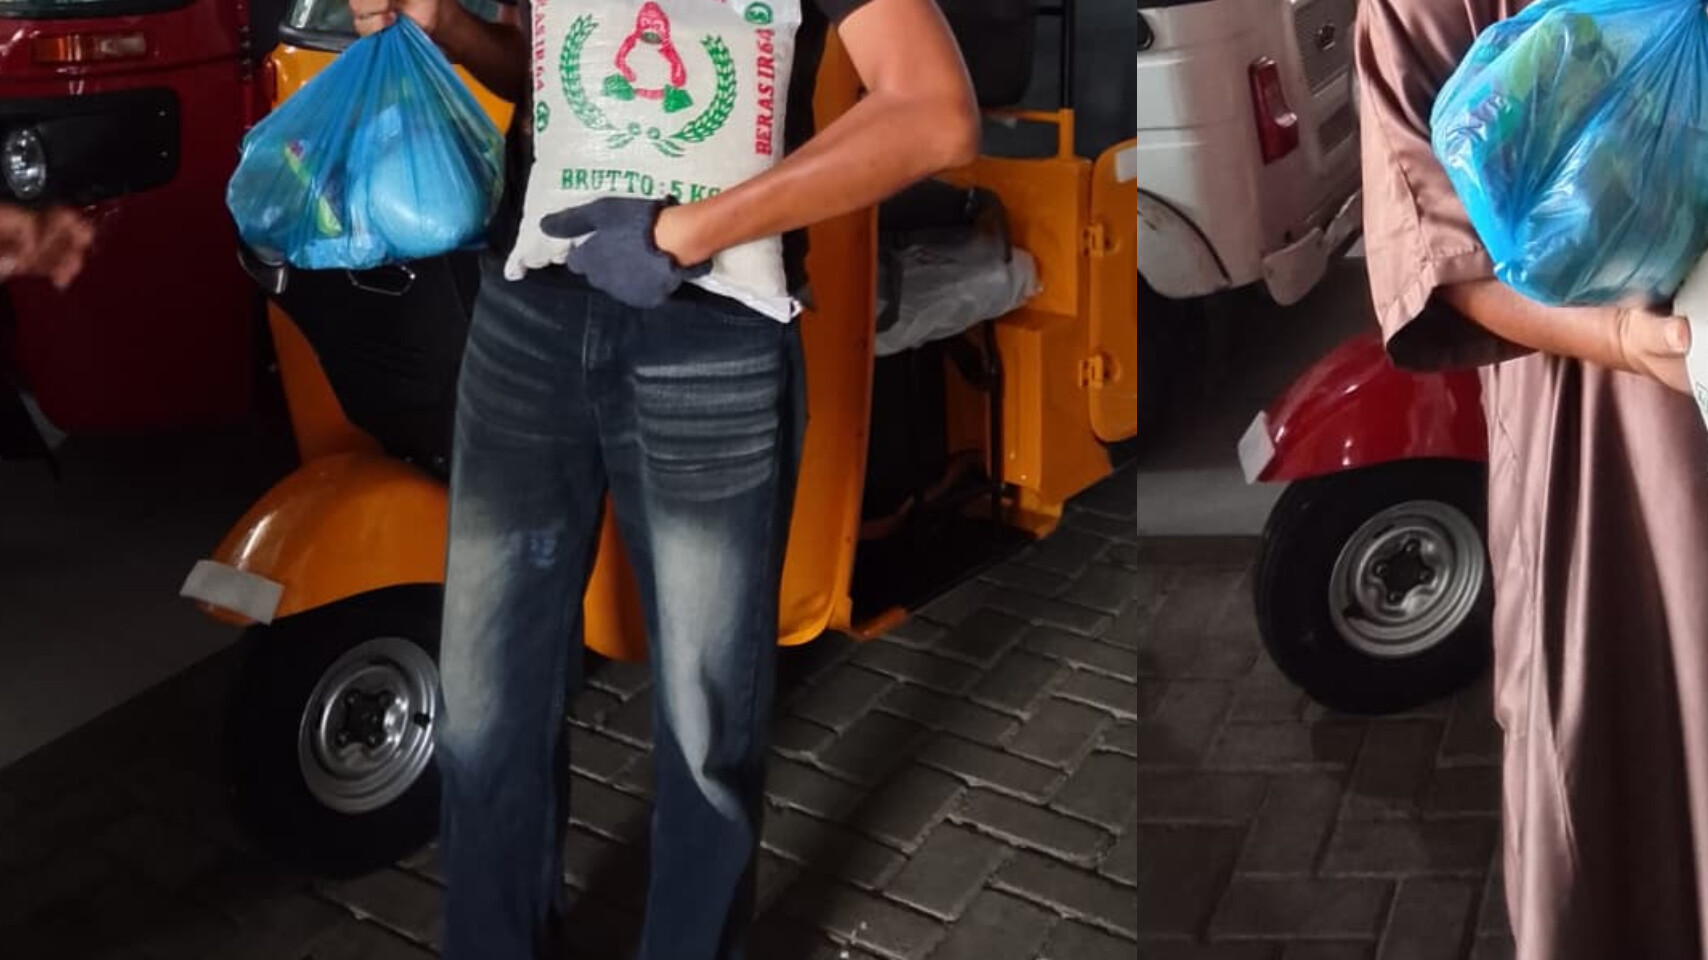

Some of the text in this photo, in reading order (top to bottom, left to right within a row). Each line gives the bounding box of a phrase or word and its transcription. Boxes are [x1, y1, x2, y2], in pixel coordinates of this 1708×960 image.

[755, 82, 775, 156] BERAS
[560, 167, 654, 196] BRUTTO
[670, 179, 684, 201] 5
